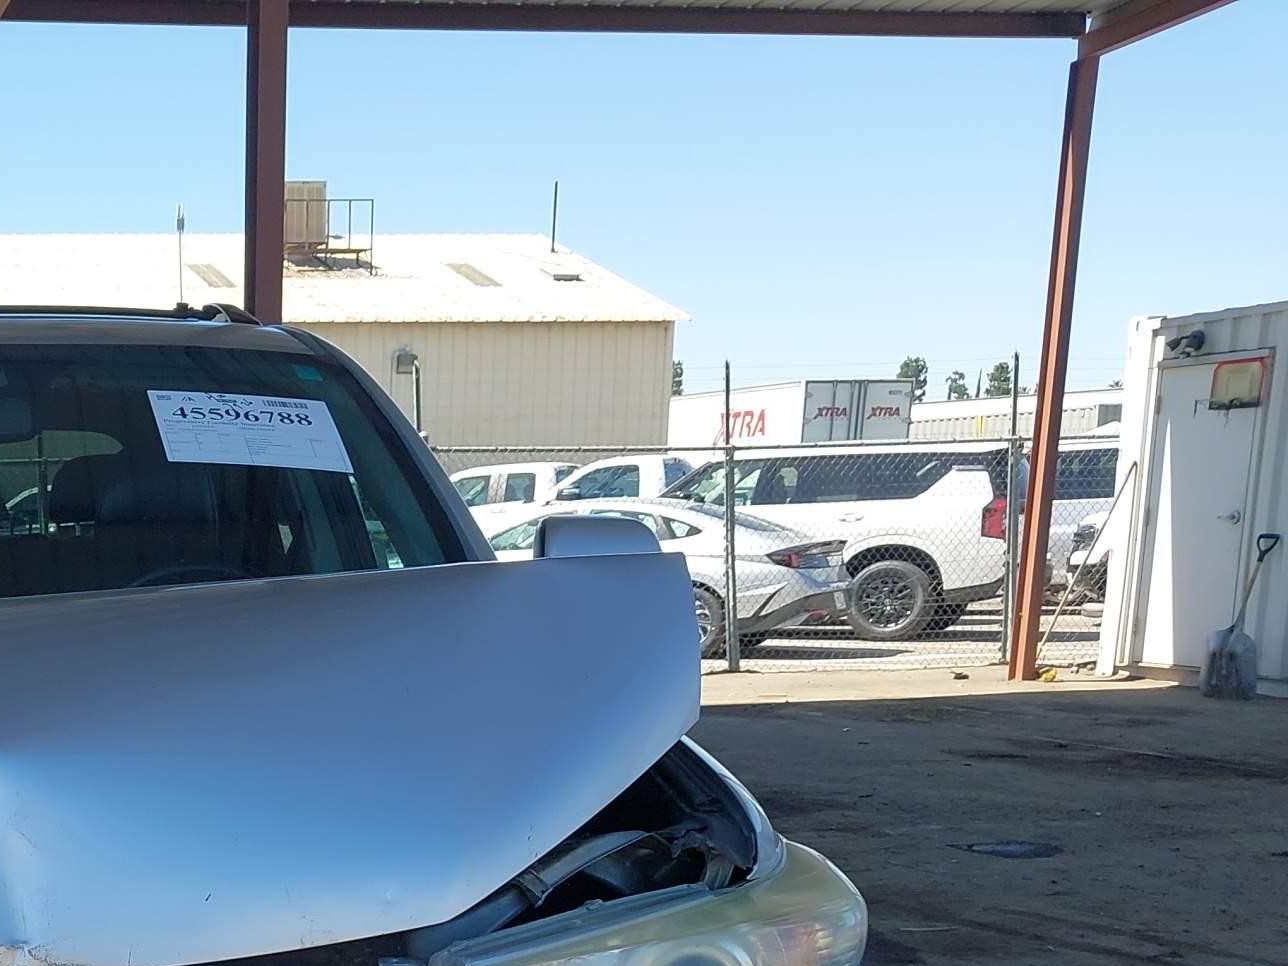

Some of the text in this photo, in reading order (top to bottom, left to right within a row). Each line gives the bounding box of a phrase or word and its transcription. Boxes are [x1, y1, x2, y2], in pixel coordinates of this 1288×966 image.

[172, 406, 313, 426] 45596788
[813, 406, 847, 420] XTRA
[866, 406, 900, 420] XTRA
